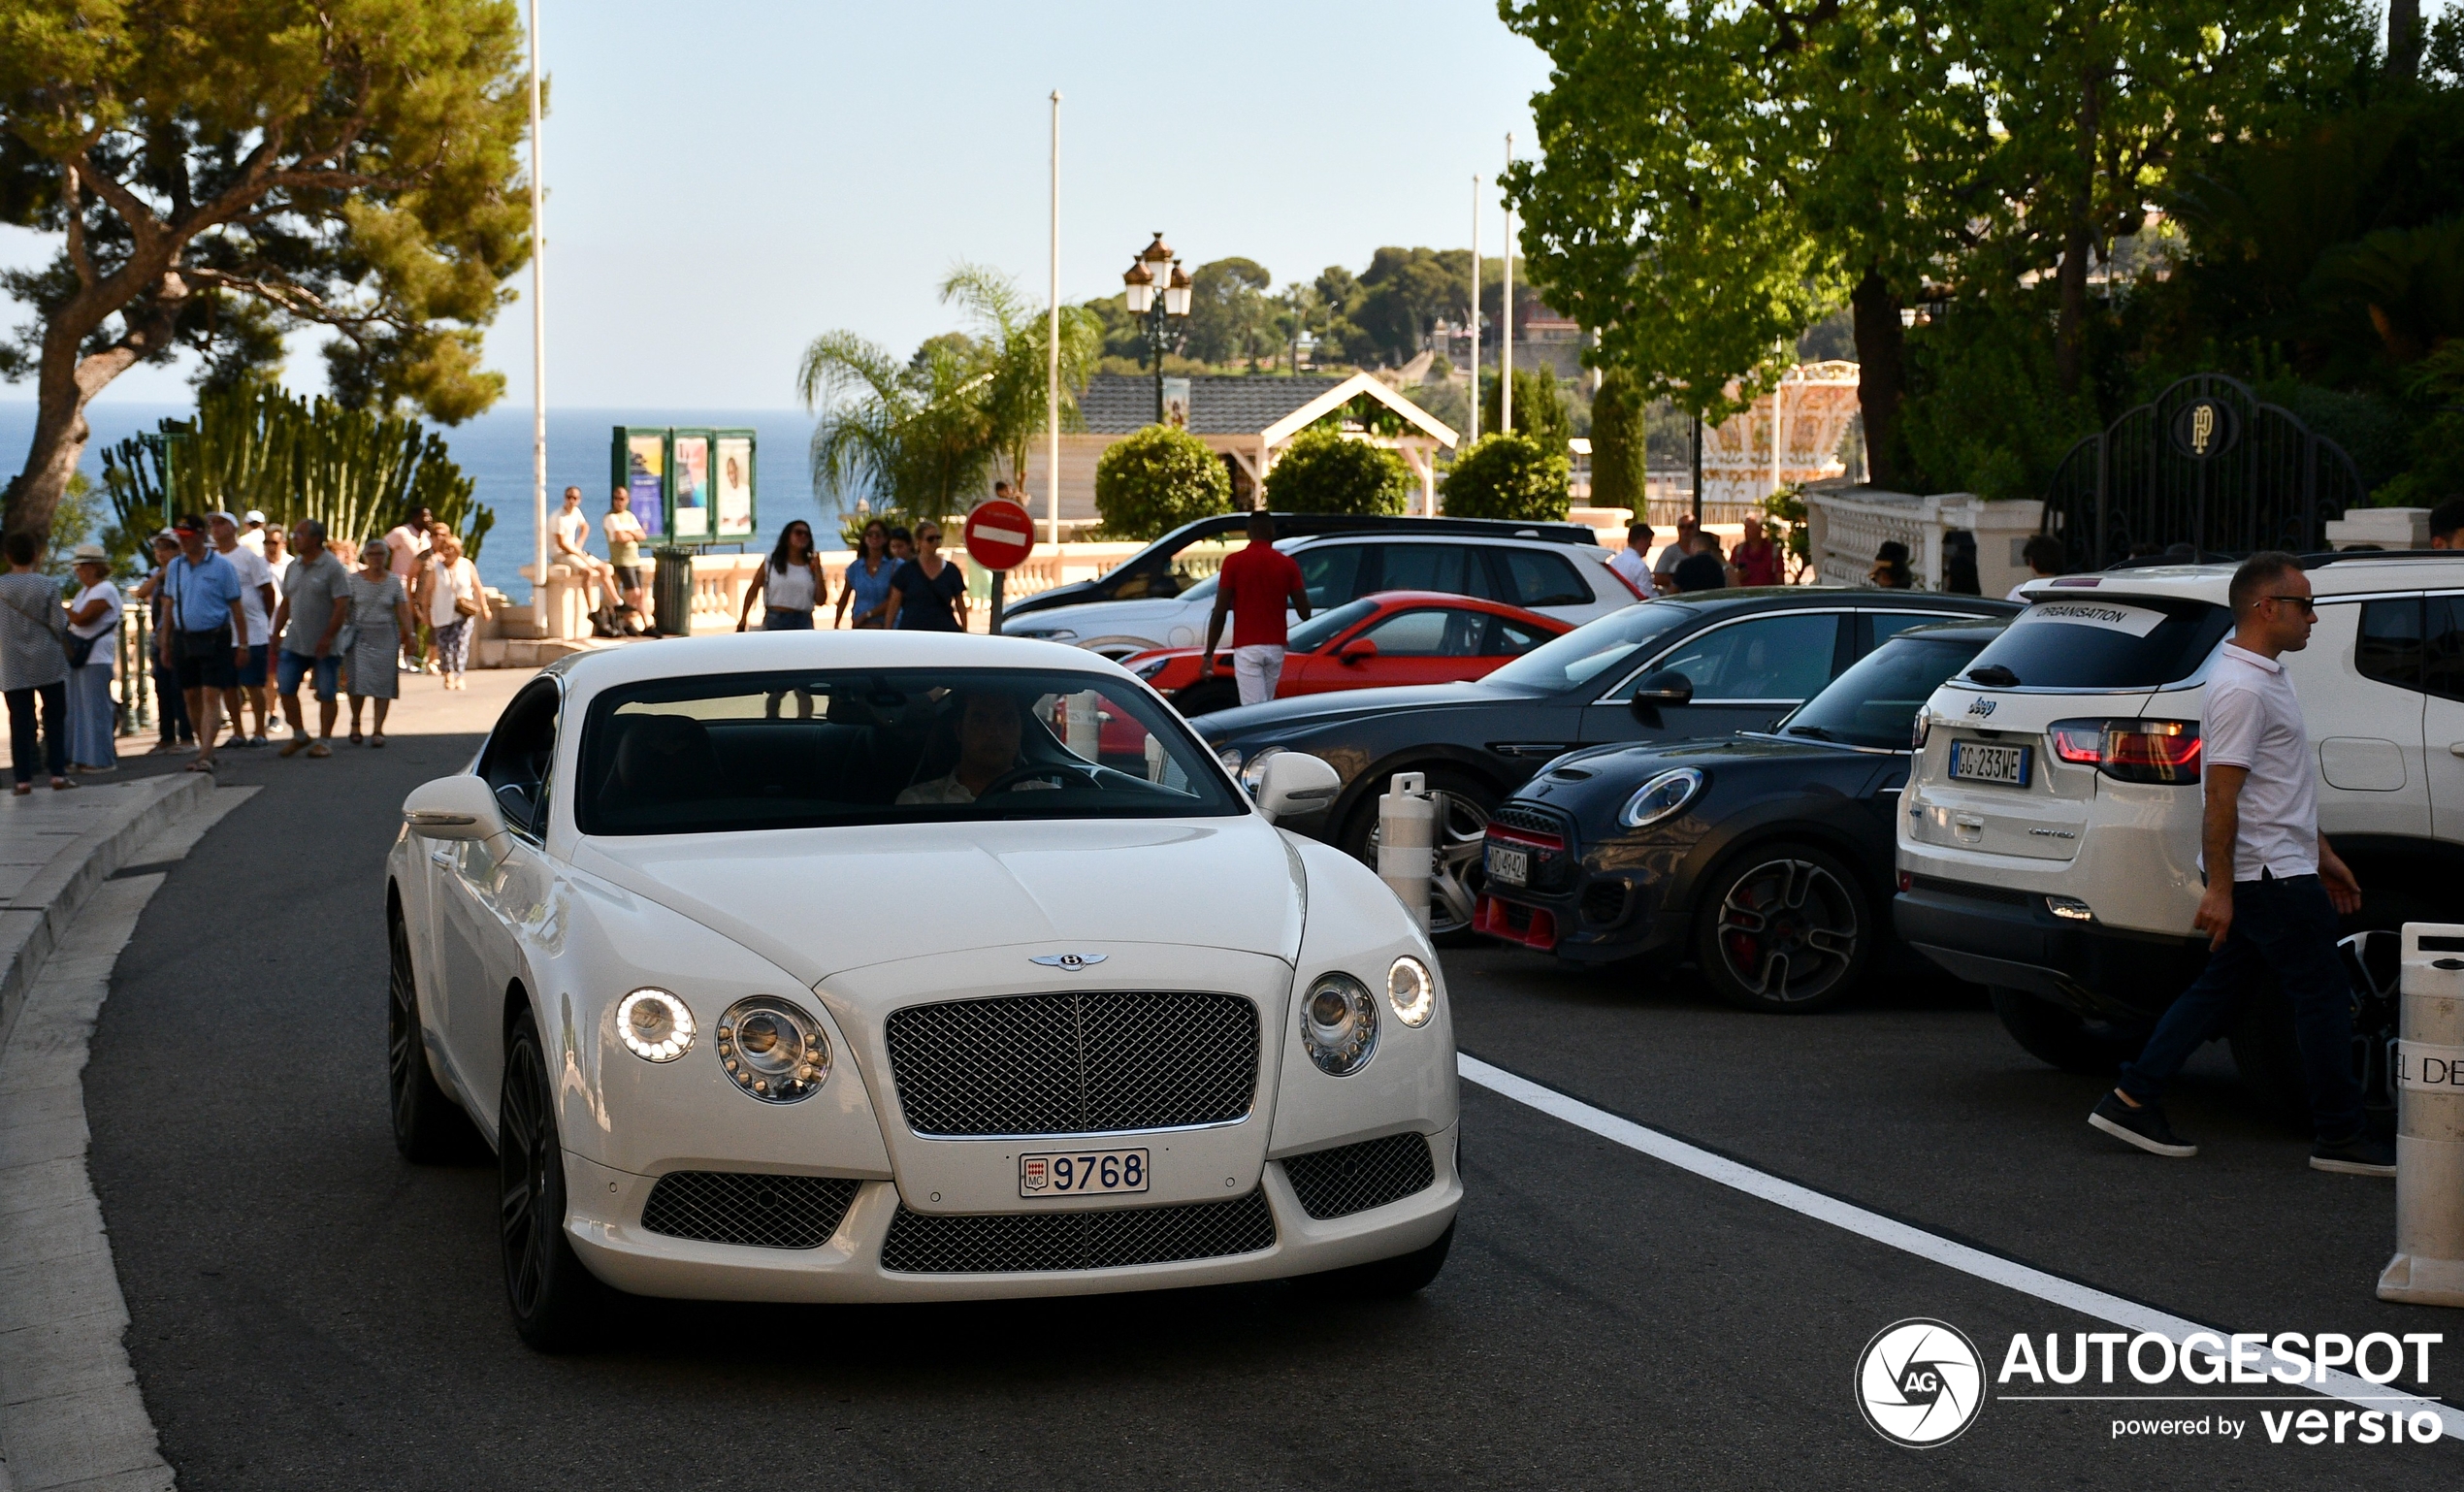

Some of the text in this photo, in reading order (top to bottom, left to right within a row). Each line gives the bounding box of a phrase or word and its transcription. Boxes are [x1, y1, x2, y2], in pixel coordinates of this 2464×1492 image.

[2036, 606, 2126, 623] ORGANISATION
[1967, 696, 1997, 719] Jeep
[1028, 1175, 1044, 1186] MC
[1054, 1153, 1143, 1191] 9768
